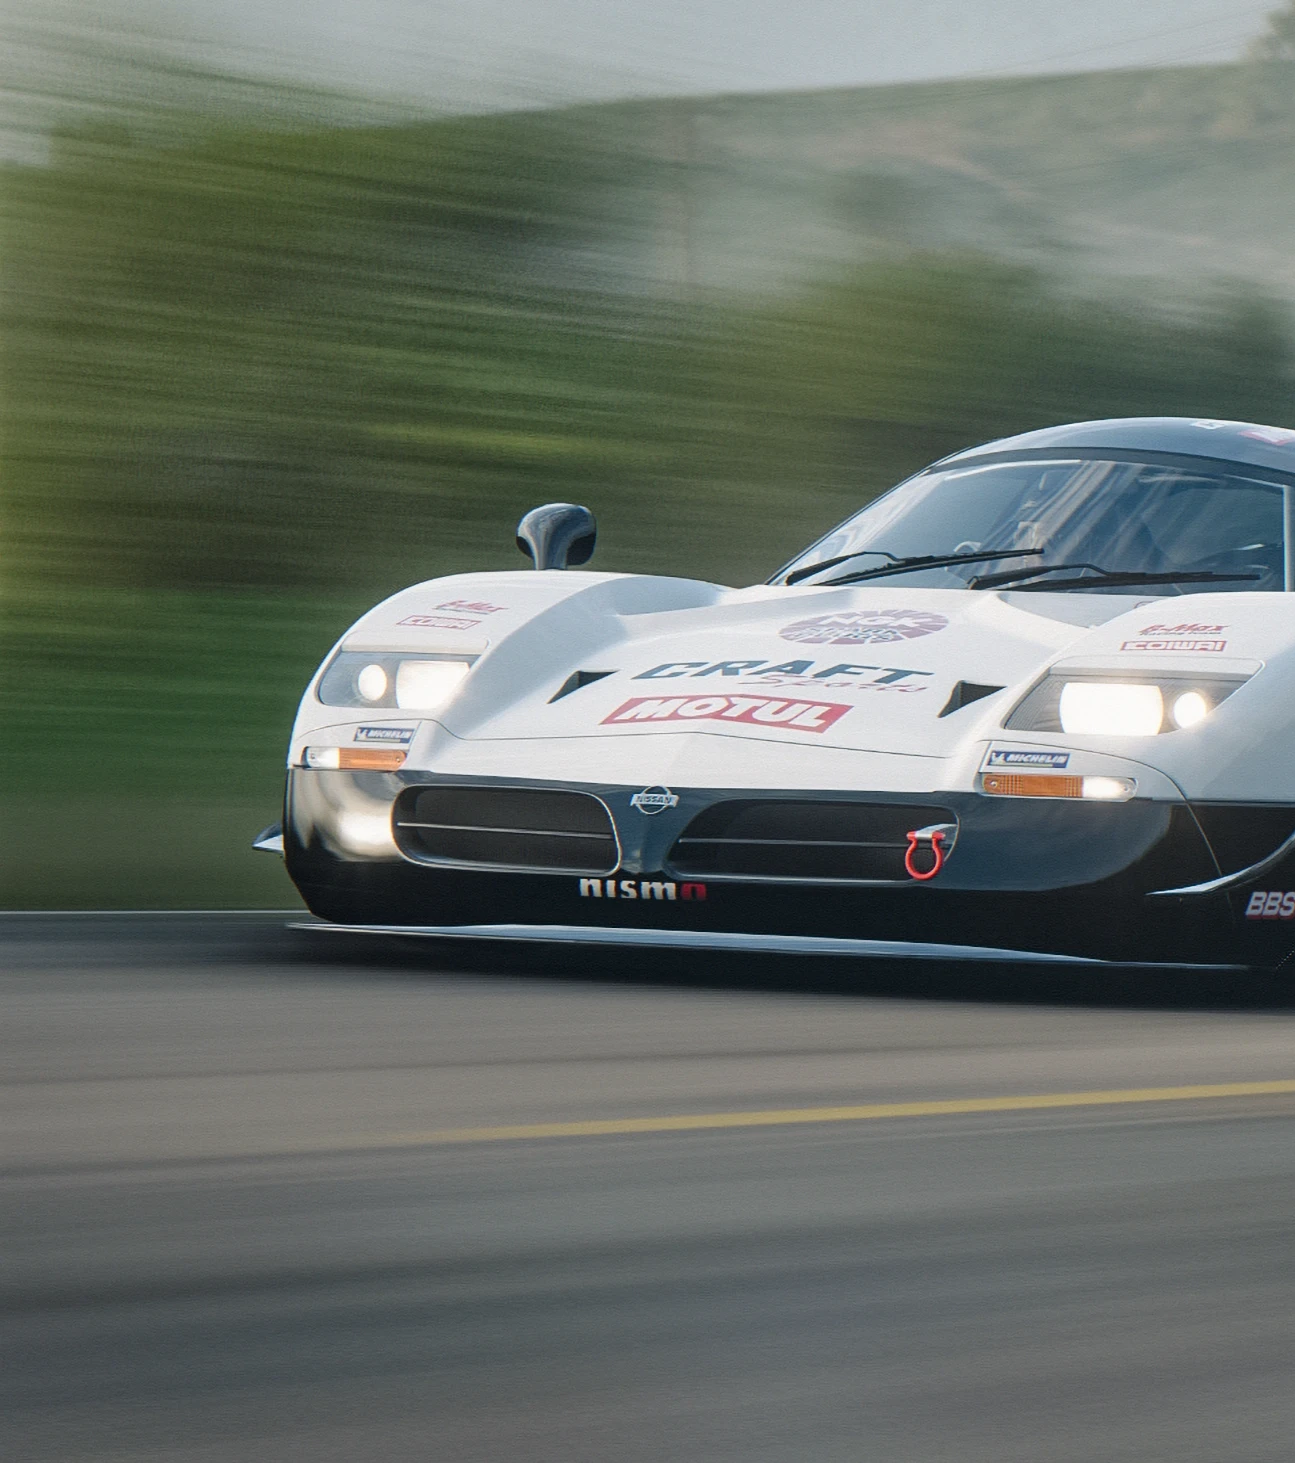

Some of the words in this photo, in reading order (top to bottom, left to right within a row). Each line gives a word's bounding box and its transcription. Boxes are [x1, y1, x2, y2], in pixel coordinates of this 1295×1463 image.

[816, 614, 933, 627] NGK
[631, 660, 934, 684] CRAFT
[613, 696, 833, 728] MOTUL
[1006, 753, 1068, 764] MICHELIN
[635, 794, 672, 804] NISSAN
